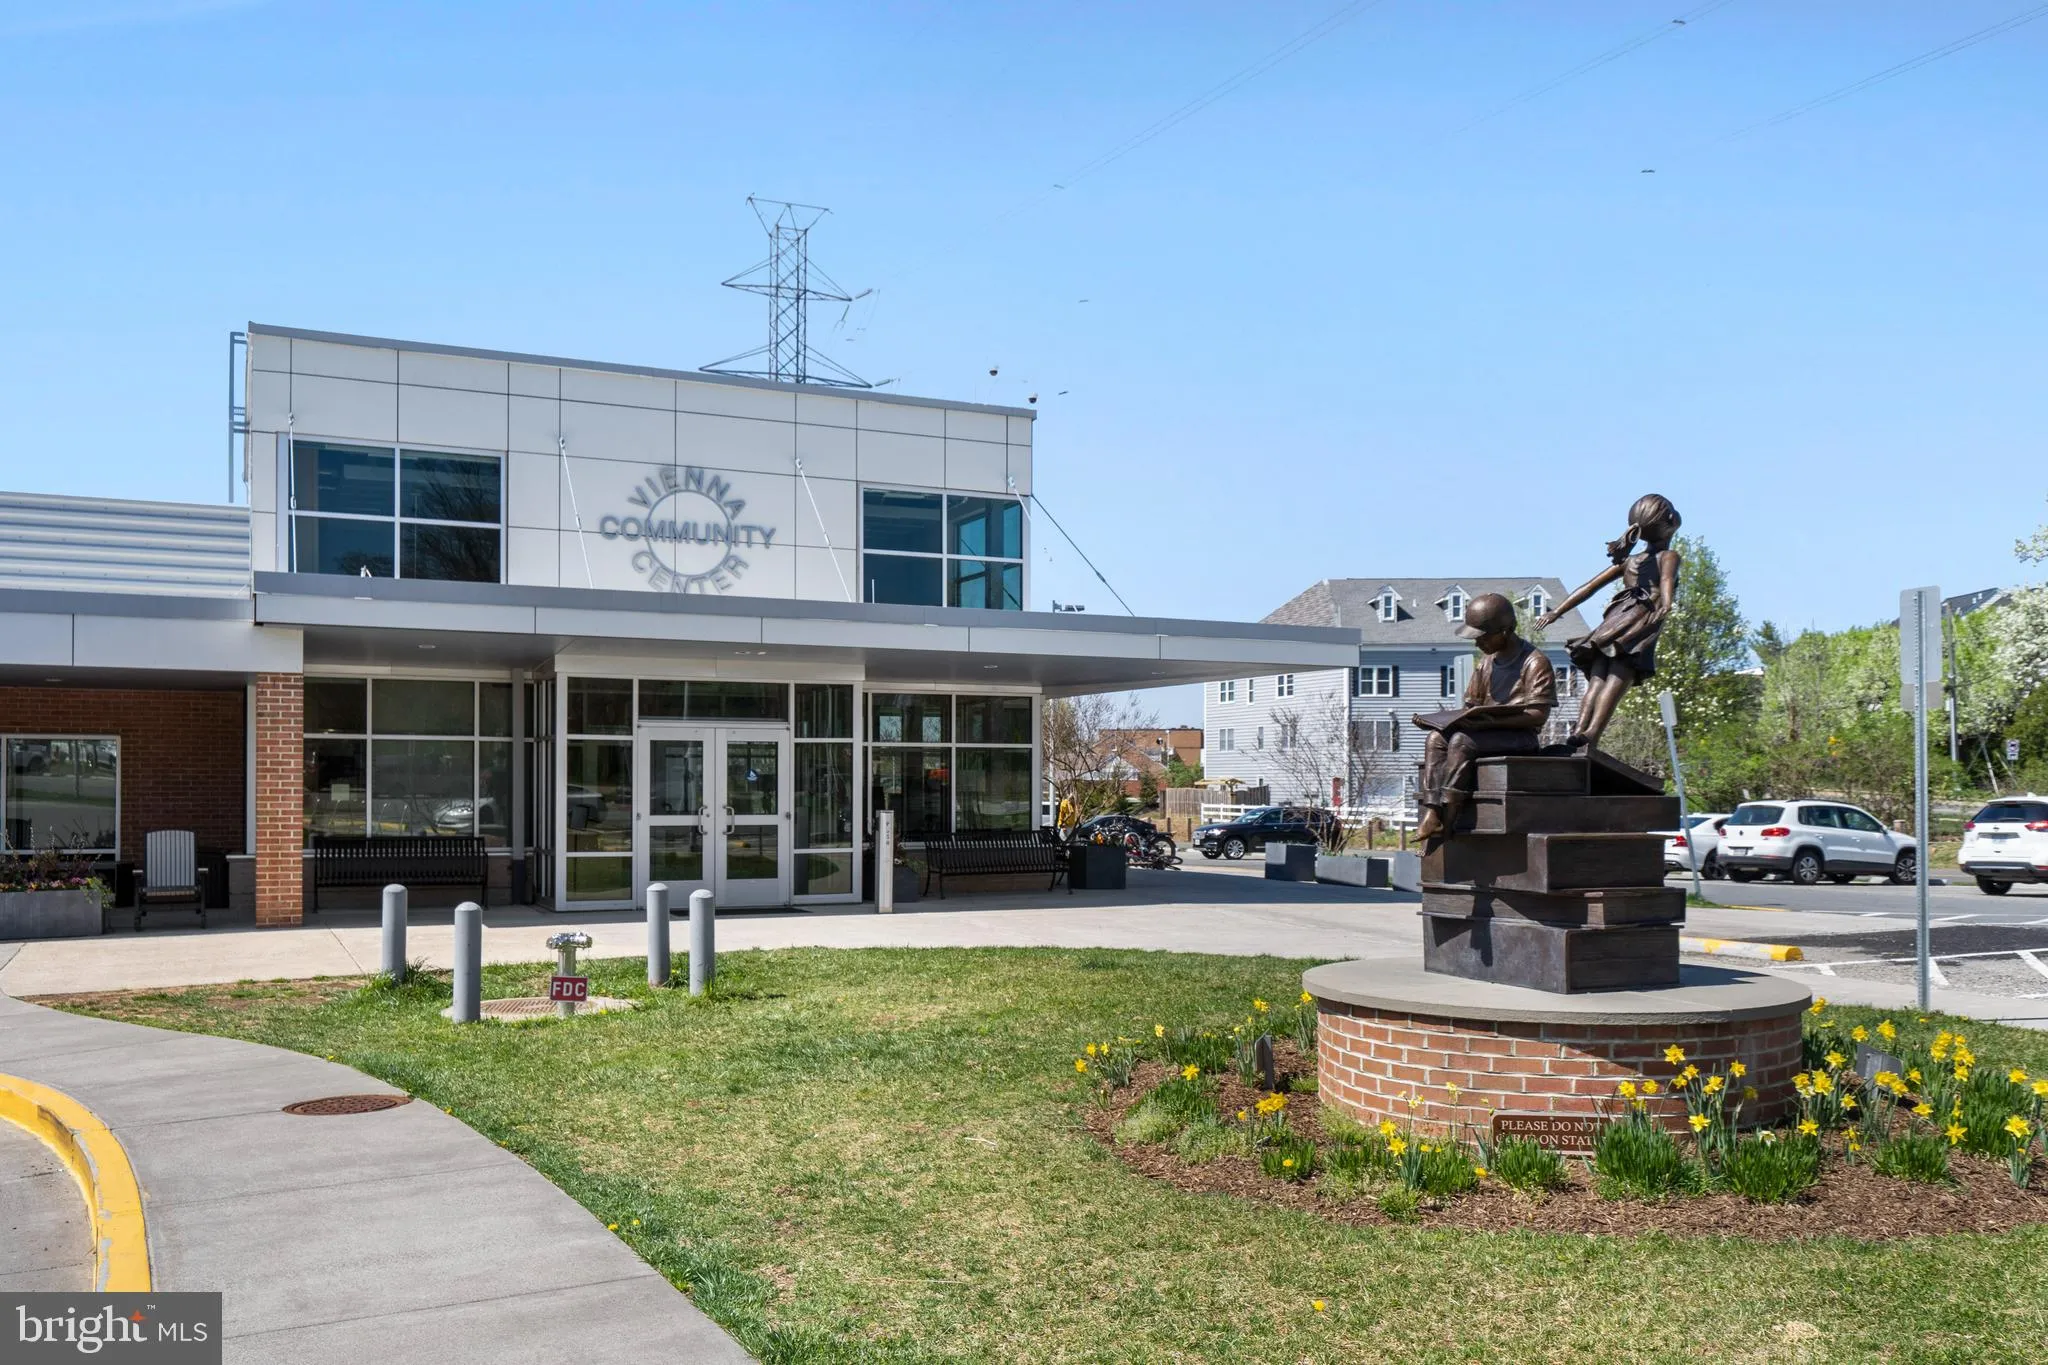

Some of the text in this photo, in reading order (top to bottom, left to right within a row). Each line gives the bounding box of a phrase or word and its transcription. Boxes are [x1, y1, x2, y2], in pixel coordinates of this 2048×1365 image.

[627, 465, 746, 520] VIENNA
[599, 515, 776, 549] COMMUNITY
[631, 549, 749, 594] CENTER
[552, 981, 585, 997] FDC
[1501, 1119, 1549, 1131] PLEASE
[1552, 1121, 1571, 1132] DO
[1540, 1134, 1559, 1145] ON
[1561, 1134, 1604, 1147] STAT
